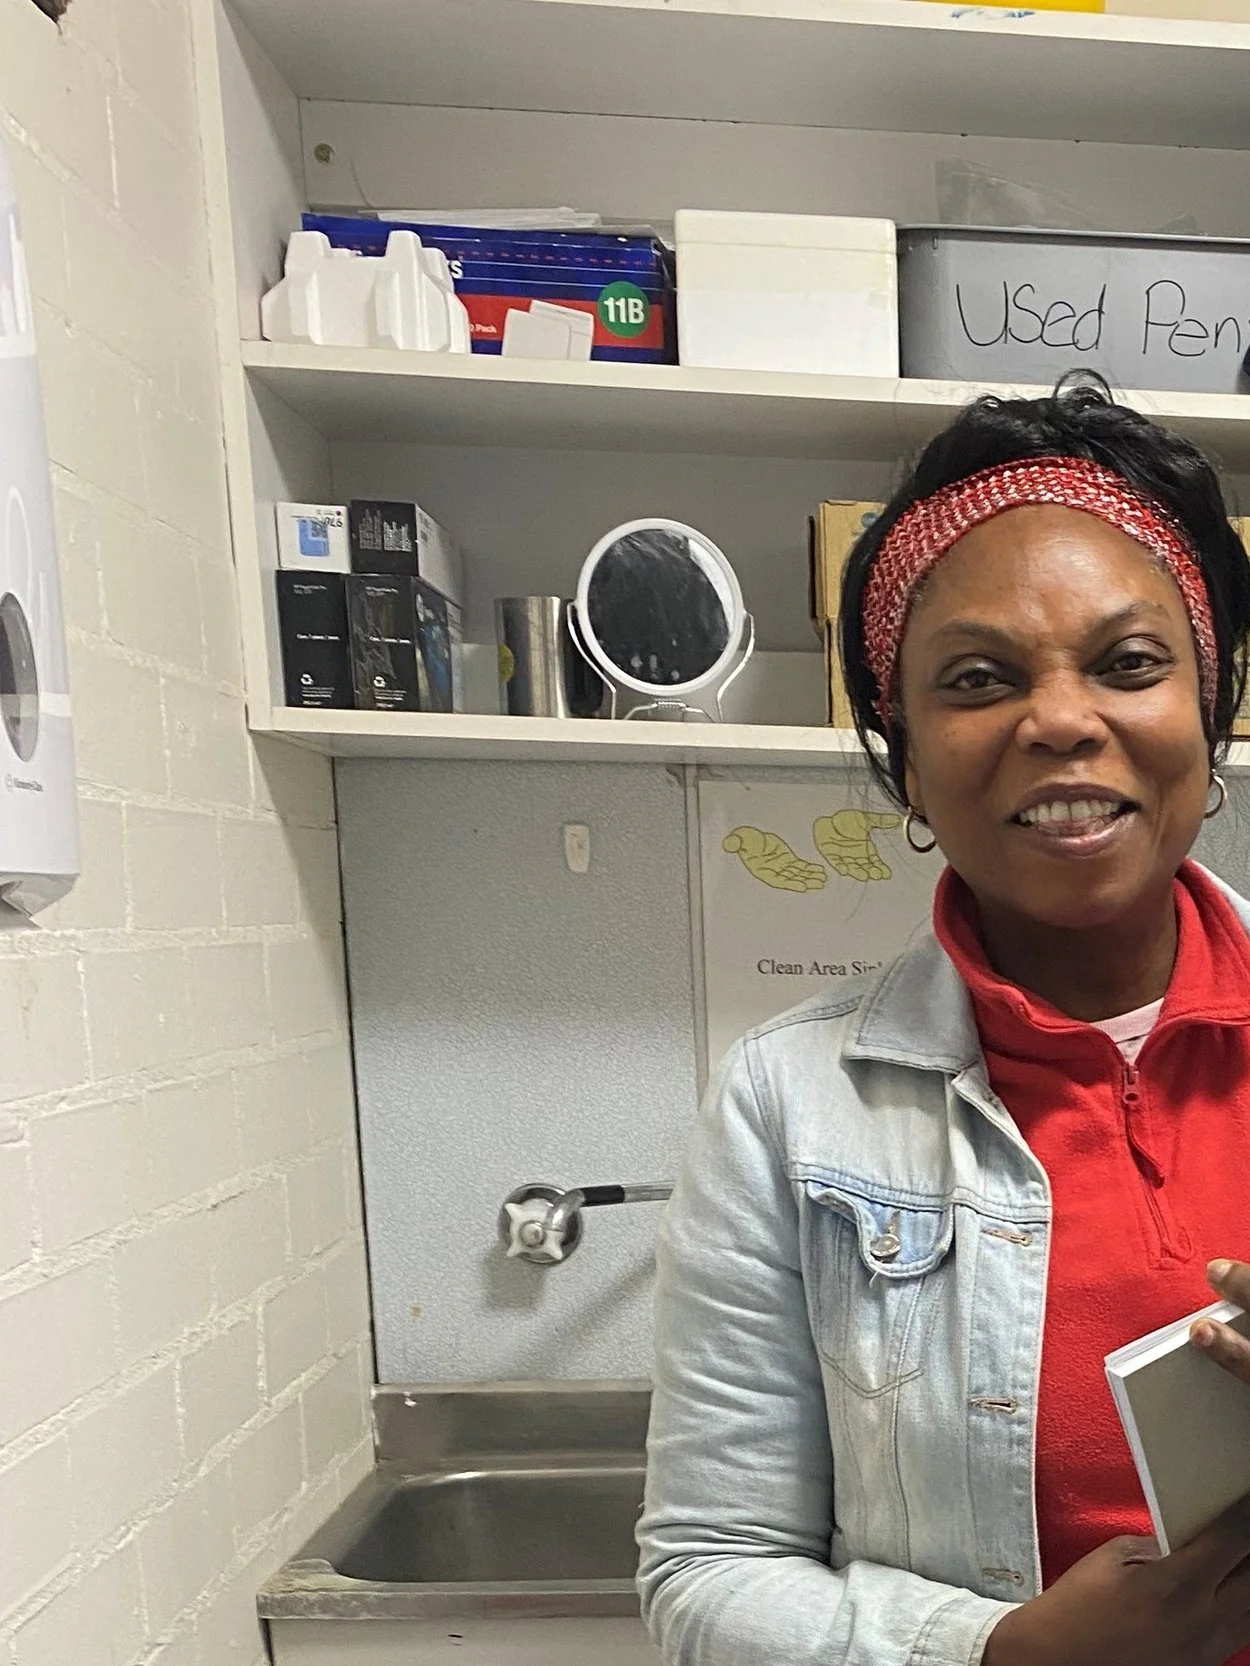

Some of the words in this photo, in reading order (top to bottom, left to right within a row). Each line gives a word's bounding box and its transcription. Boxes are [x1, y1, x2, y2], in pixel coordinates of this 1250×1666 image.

[604, 297, 645, 324] 11B
[956, 281, 1106, 351] Used
[757, 959, 803, 975] Clean
[808, 961, 847, 976] Area
[851, 961, 882, 976] Si
